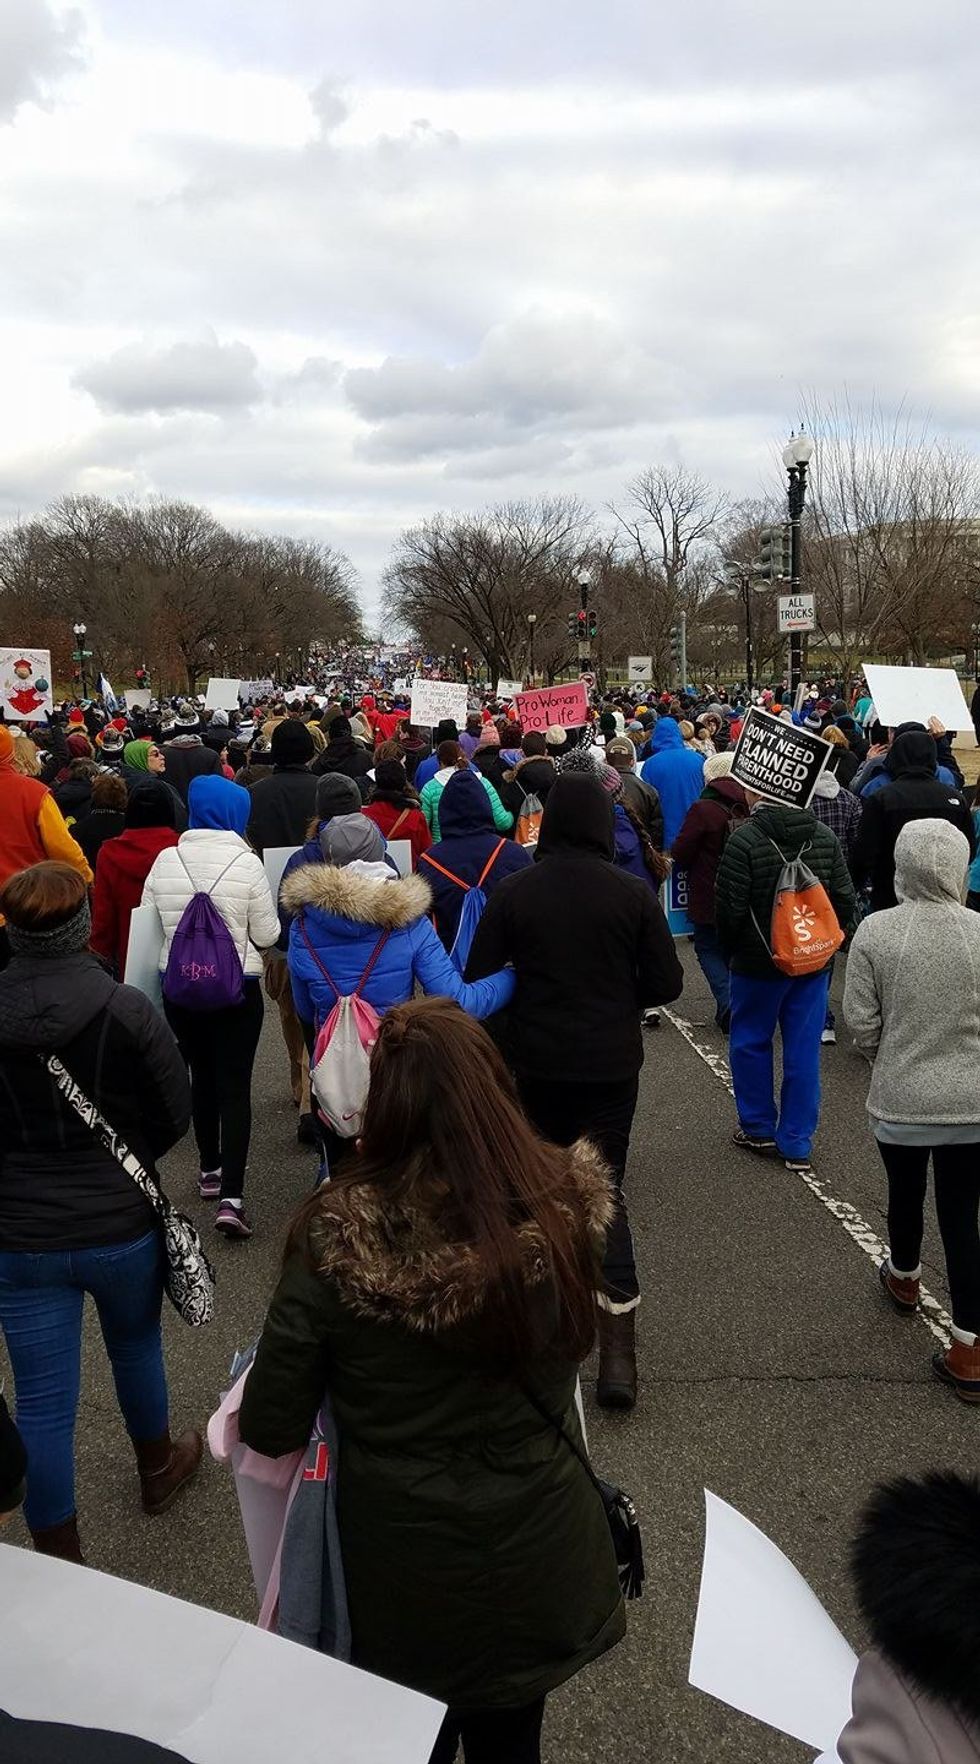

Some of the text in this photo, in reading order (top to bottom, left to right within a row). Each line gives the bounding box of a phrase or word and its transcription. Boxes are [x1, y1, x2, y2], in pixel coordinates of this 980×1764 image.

[788, 597, 804, 607] ALL
[780, 607, 814, 620] TRUCKS
[516, 697, 539, 714] Pro
[774, 724, 787, 736] WE
[747, 723, 815, 765] DON'T NEED
[741, 738, 809, 781] PLANNED
[737, 754, 803, 793] PARENTHOOD
[180, 961, 217, 982] KBM
